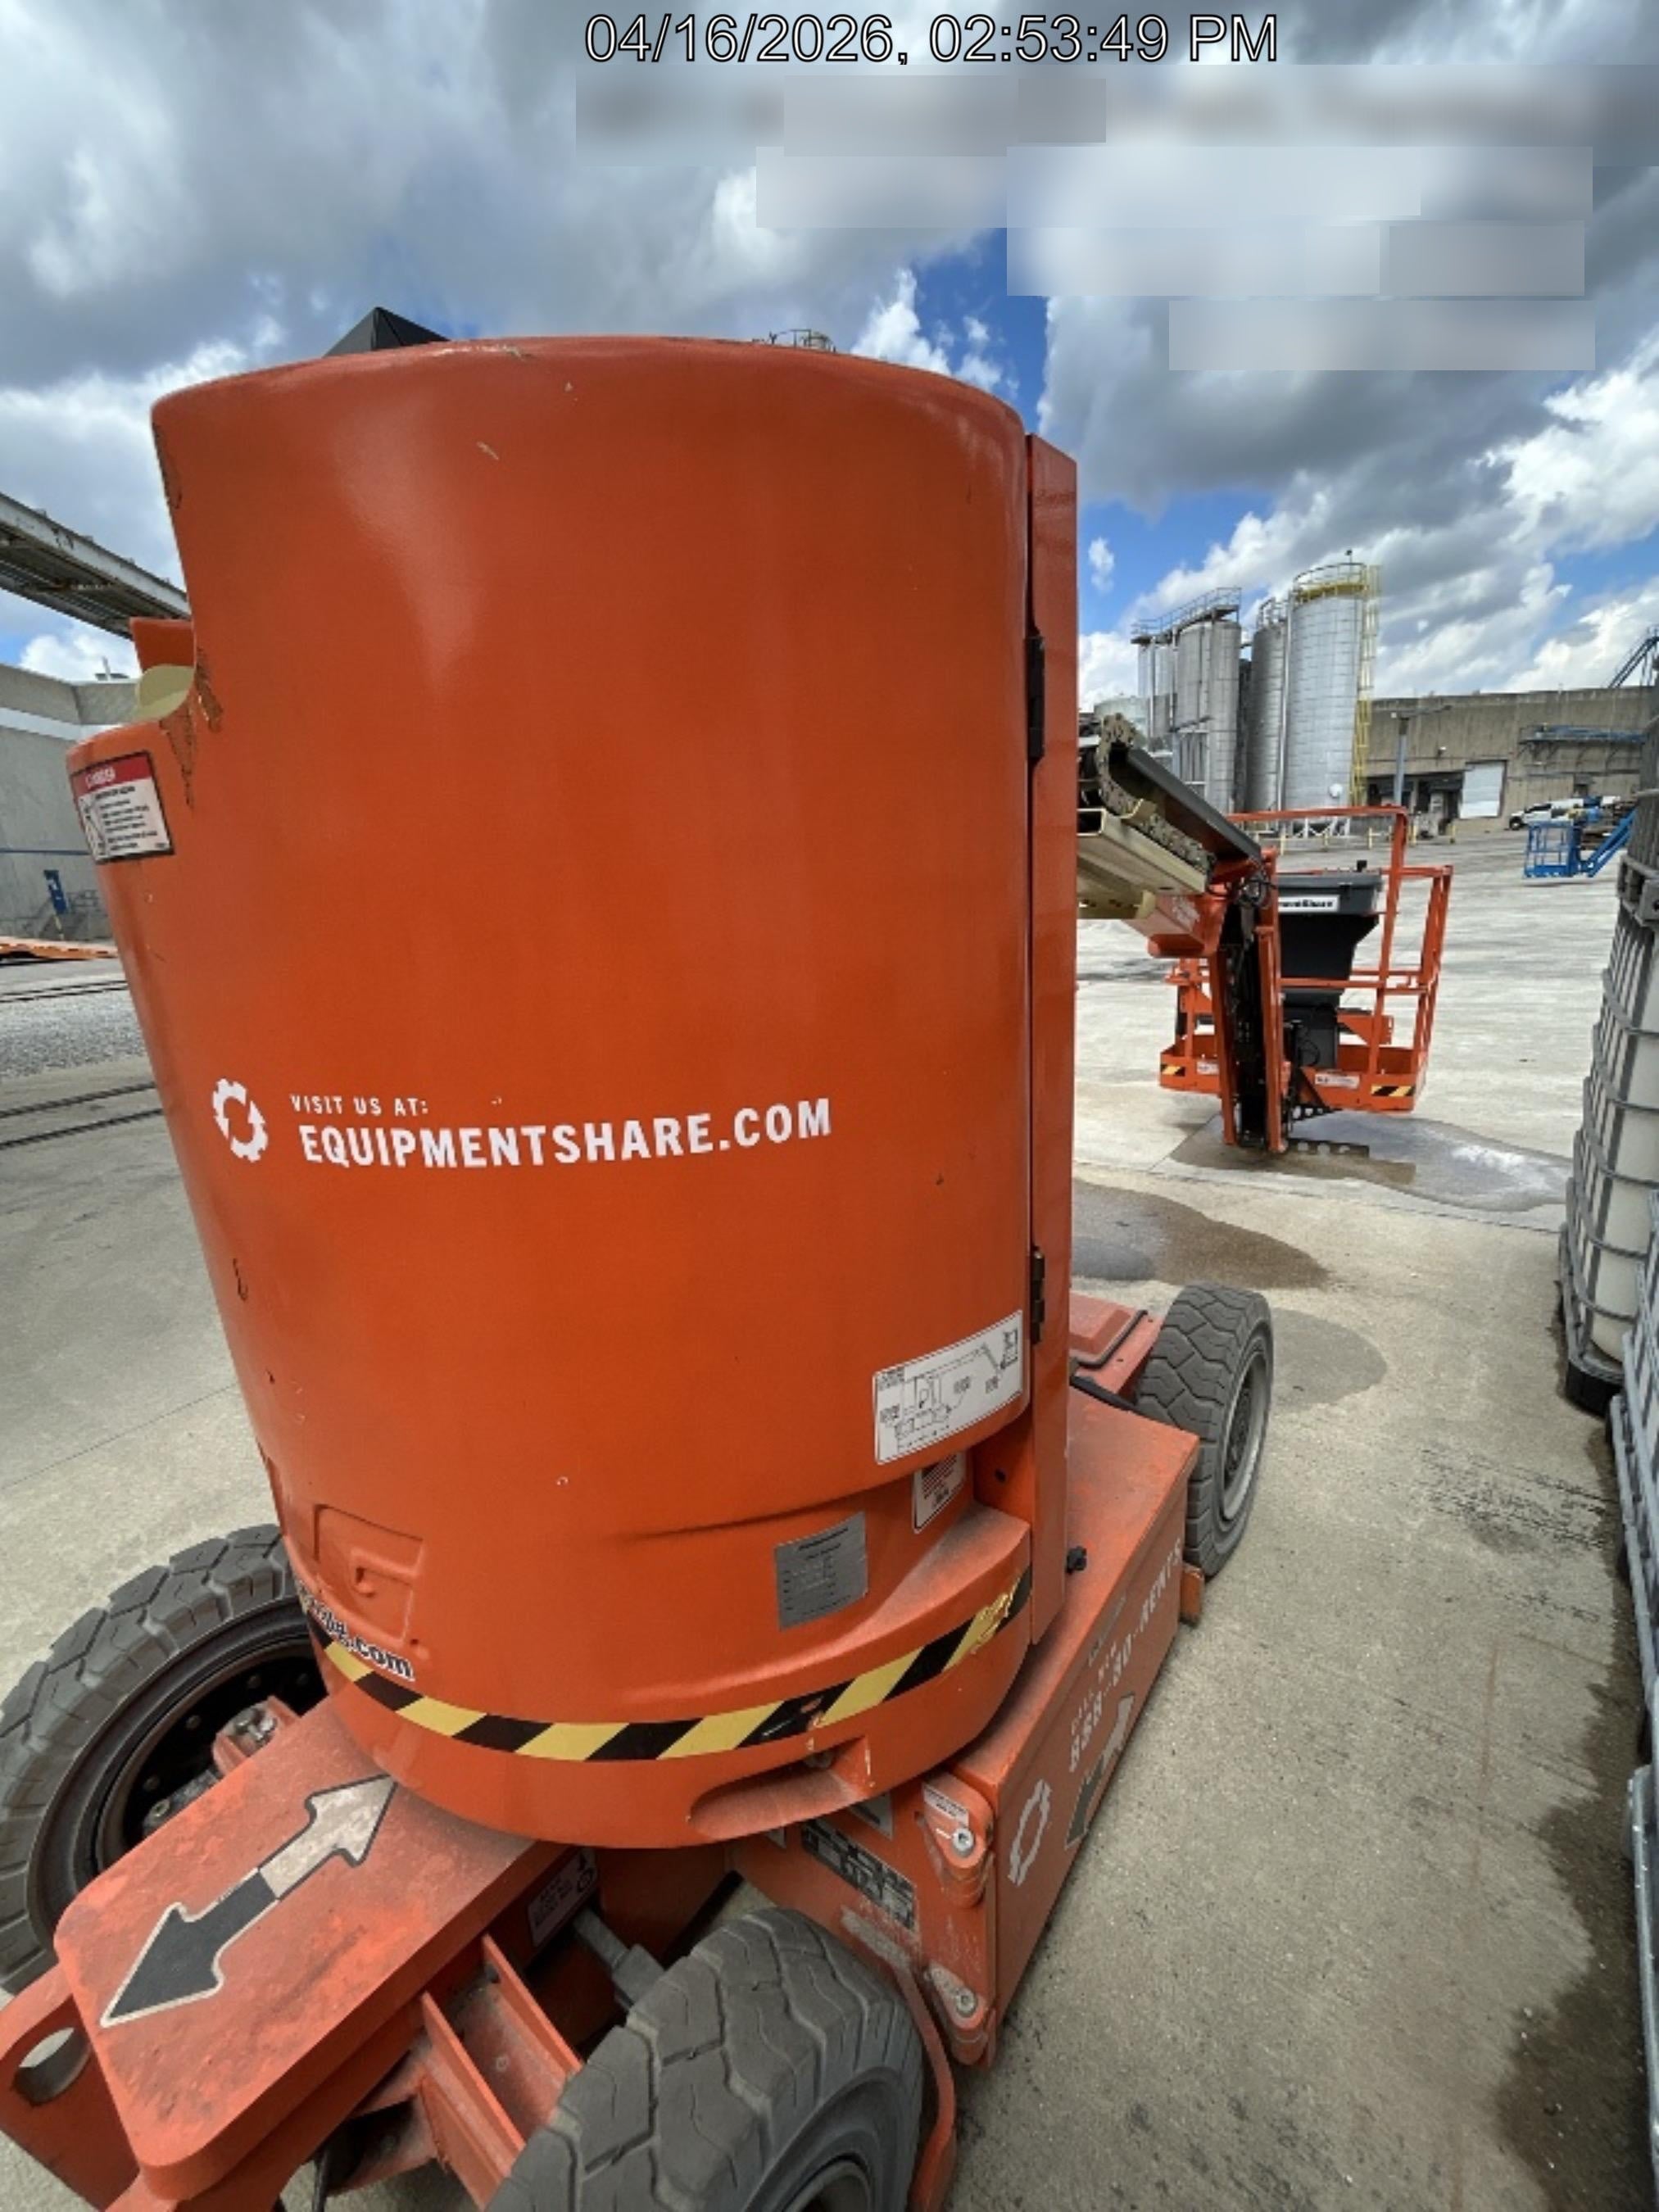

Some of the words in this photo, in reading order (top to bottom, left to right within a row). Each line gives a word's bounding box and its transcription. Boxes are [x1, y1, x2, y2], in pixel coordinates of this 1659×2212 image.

[290, 1095, 343, 1114] VISIT
[353, 1096, 382, 1116] US
[394, 1096, 429, 1117] AT:
[298, 1098, 832, 1168] EQUIPMENTSHARE.COM
